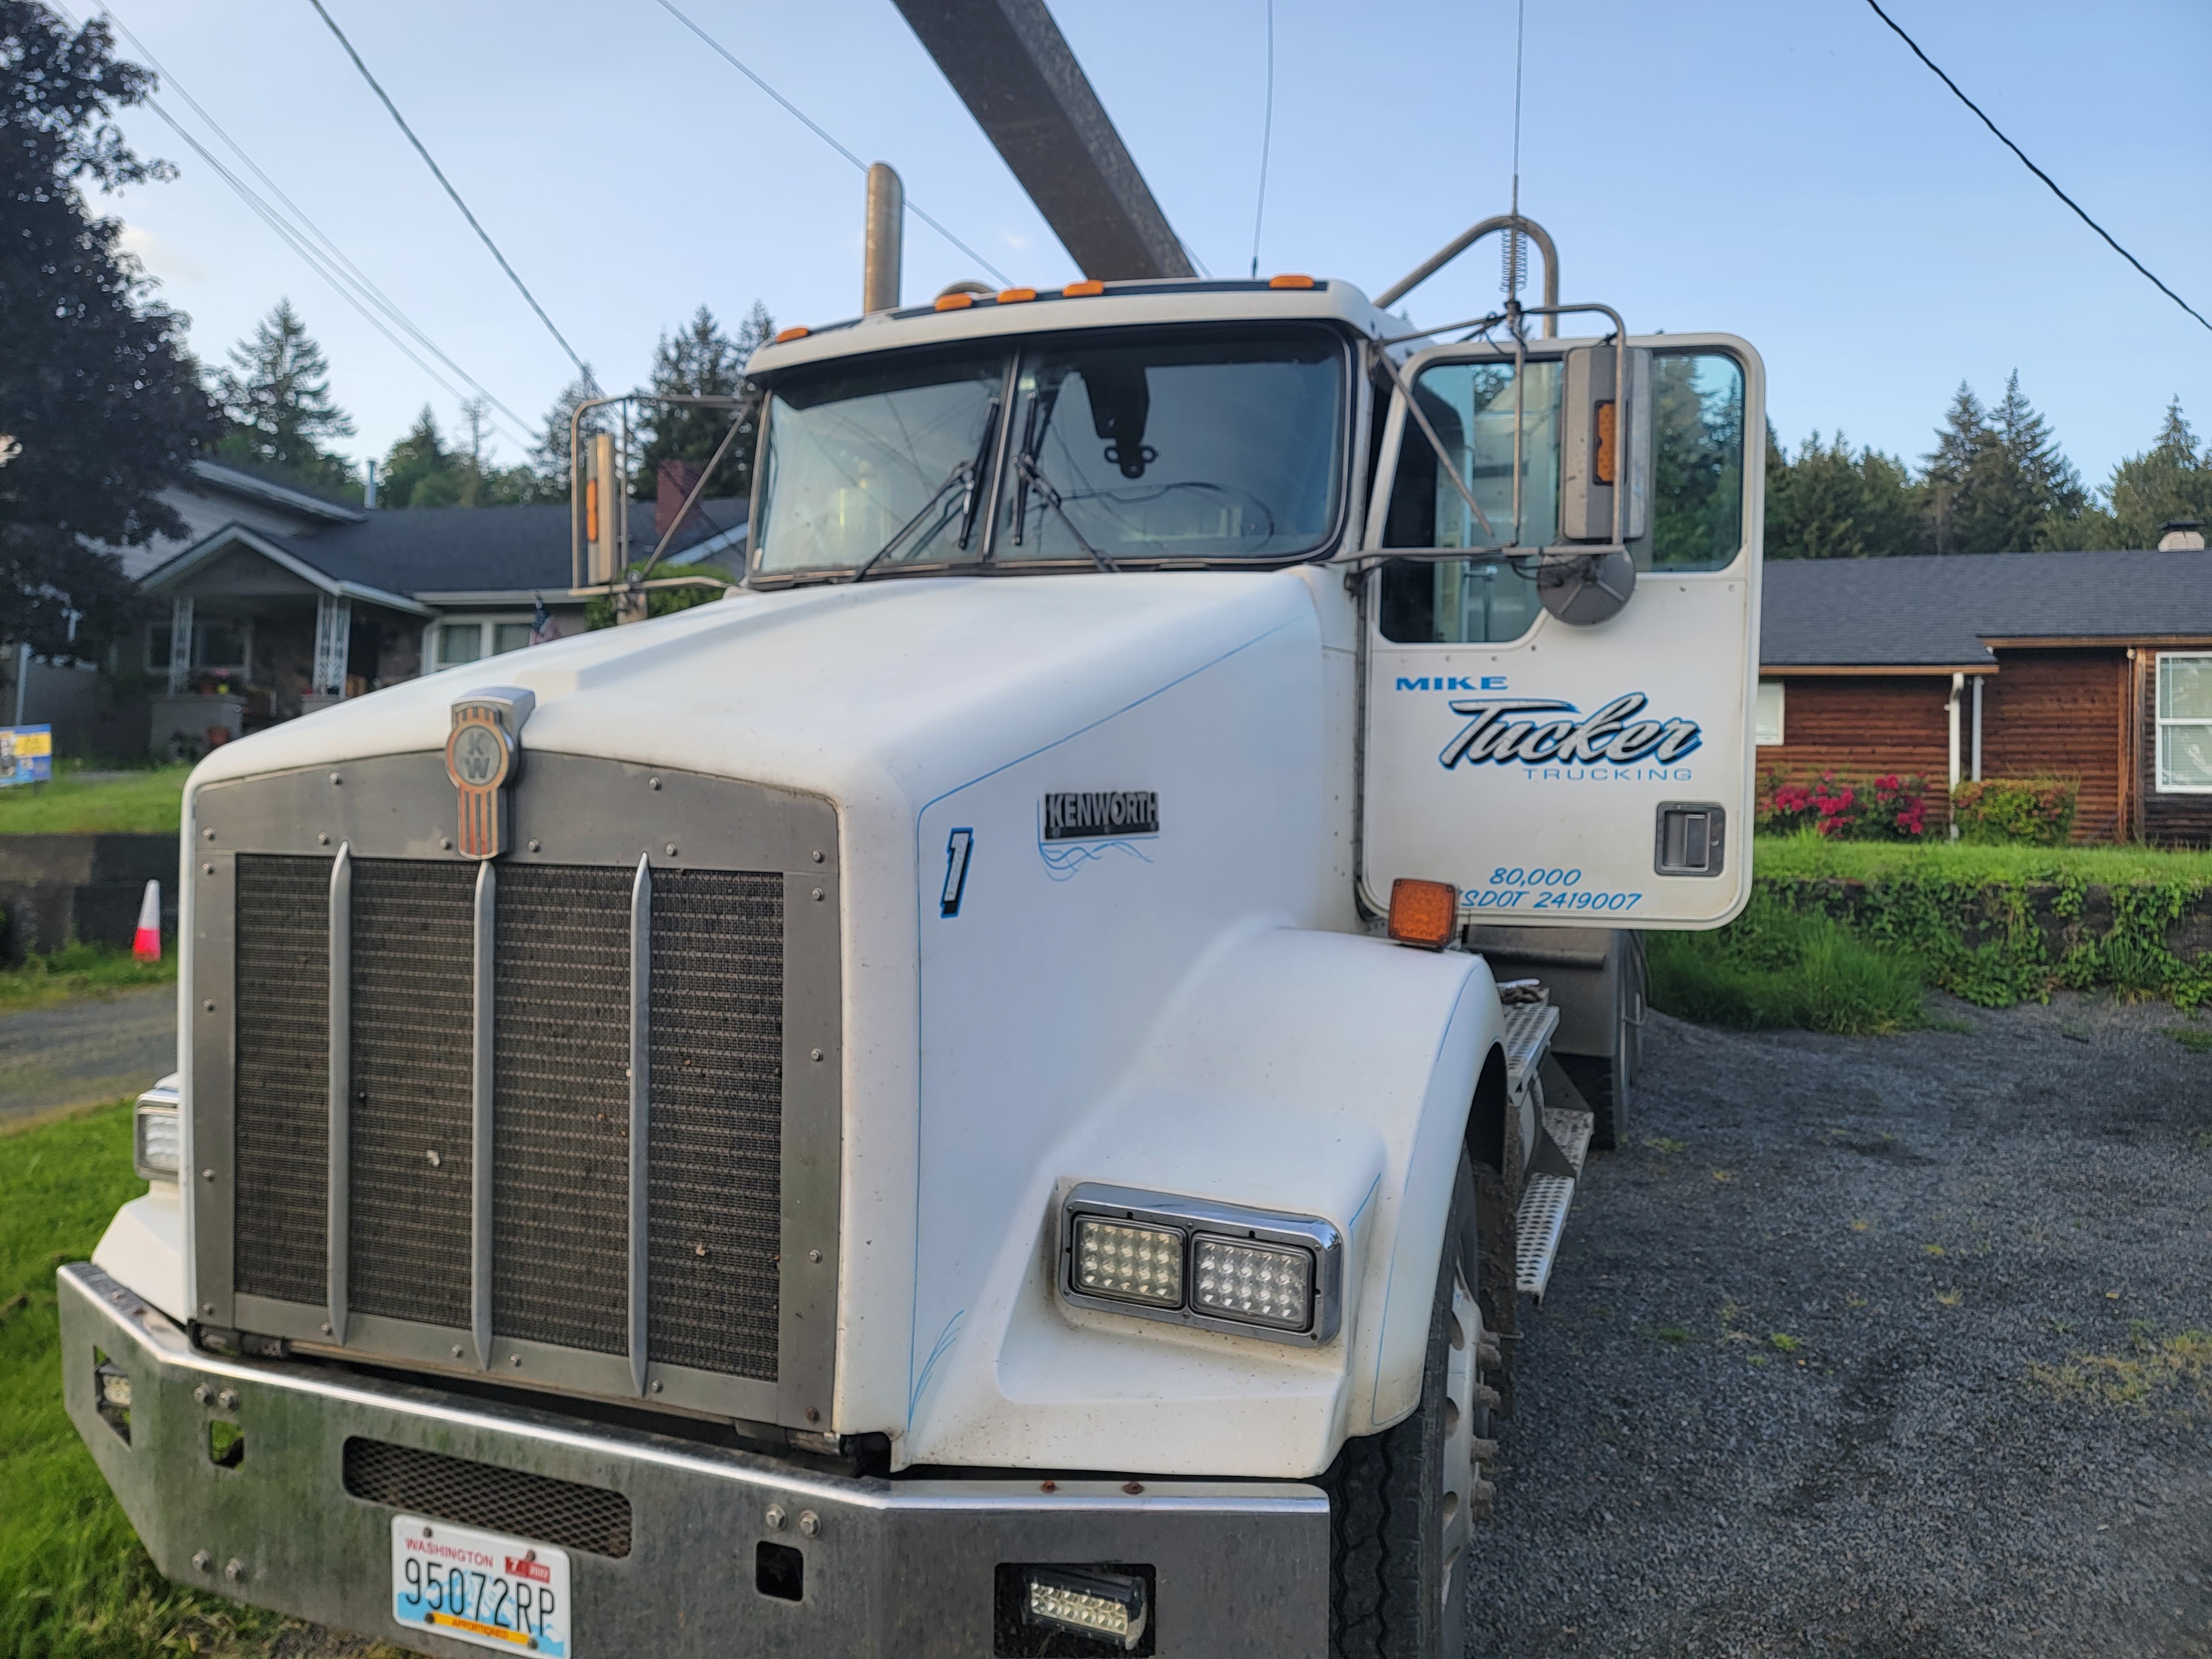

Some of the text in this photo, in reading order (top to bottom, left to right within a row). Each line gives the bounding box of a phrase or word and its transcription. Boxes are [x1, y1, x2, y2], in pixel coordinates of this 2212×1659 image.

[1395, 676, 1509, 691] MIKE
[1438, 691, 1704, 770] Tucker
[1522, 768, 1692, 781] TRUCKING
[1047, 791, 1159, 828] KENWORTH
[941, 827, 974, 919] 1
[1489, 867, 1582, 888] 80,000
[1459, 889, 1643, 910] SDOT 2419007
[405, 1538, 494, 1568] WASHINGTON
[405, 1558, 555, 1637] 95072RP
